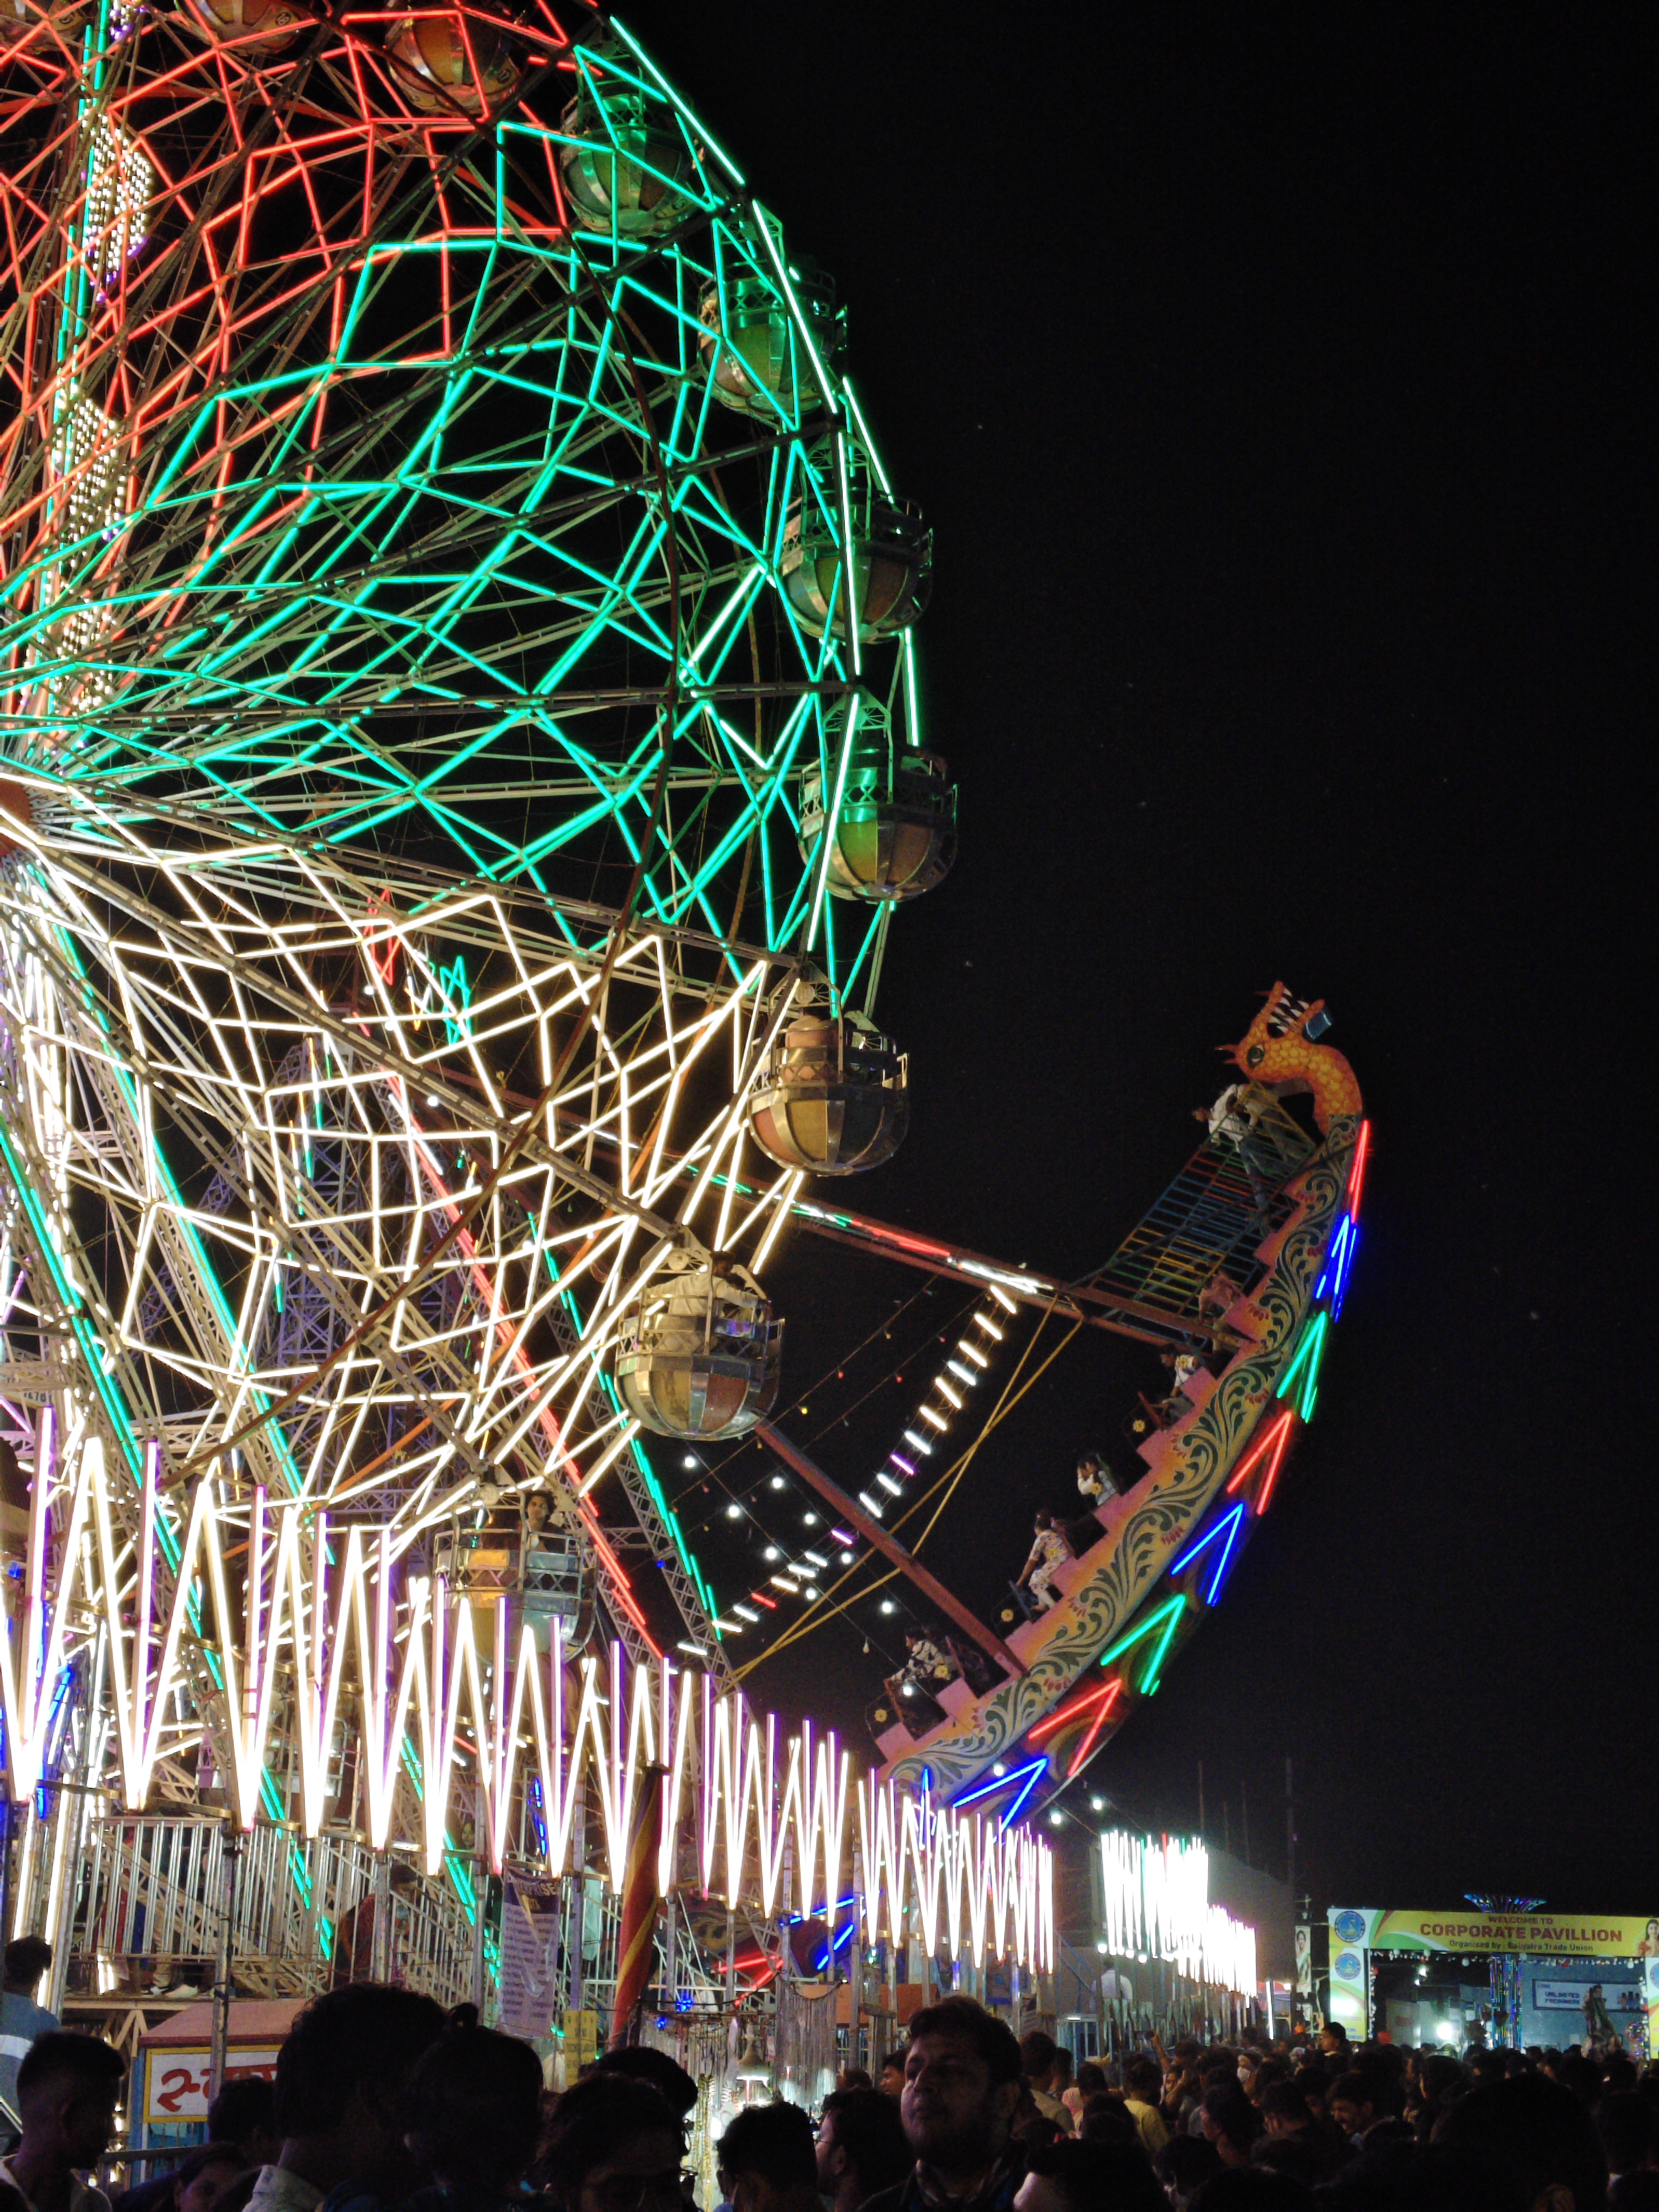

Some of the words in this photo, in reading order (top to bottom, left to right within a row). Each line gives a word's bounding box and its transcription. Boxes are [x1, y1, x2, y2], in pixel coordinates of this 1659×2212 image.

[276, 12, 291, 25] 18
[1489, 1916, 1538, 1924] WELCOME
[1540, 1917, 1554, 1925] TO
[1420, 1924, 1526, 1939] CORPORATE
[1530, 1927, 1622, 1942] PAVILLION
[1544, 1943, 1567, 1951] Trade
[1569, 1944, 1593, 1952] Union
